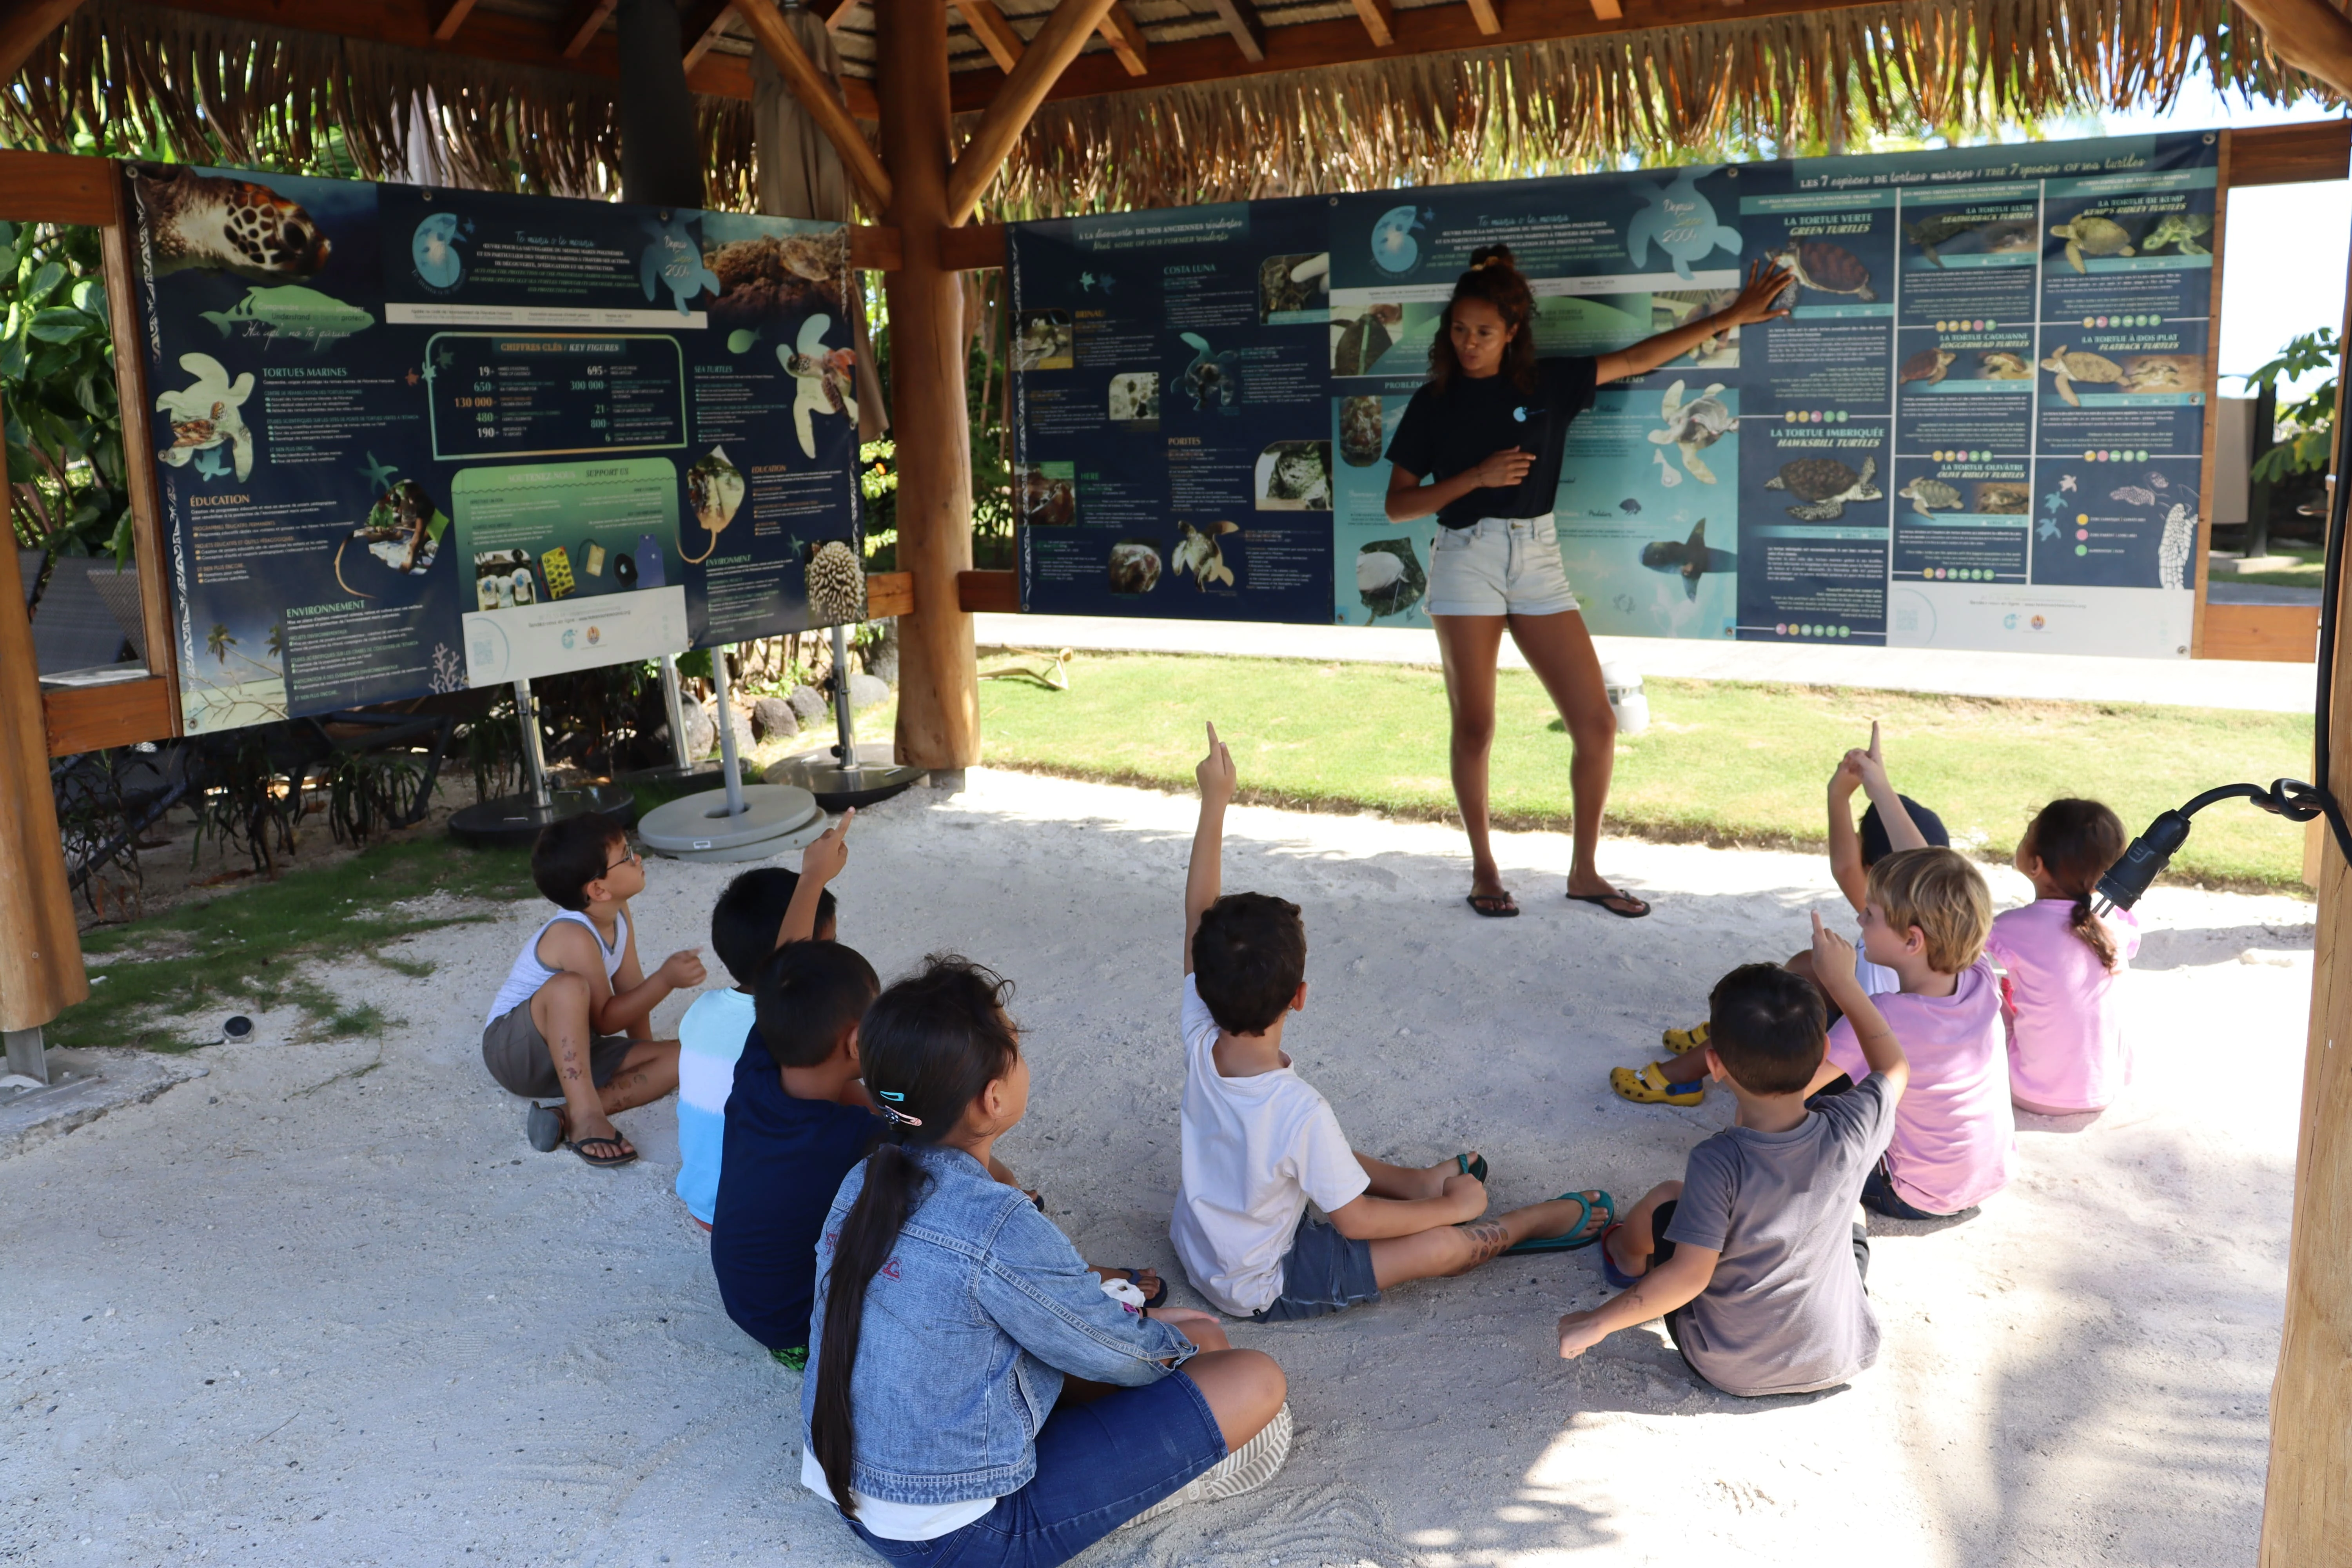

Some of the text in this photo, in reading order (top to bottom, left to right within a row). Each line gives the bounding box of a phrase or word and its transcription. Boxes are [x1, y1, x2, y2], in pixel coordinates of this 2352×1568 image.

[1800, 178, 1818, 188] LES
[1821, 175, 1828, 186] 7
[1830, 173, 1871, 190] espèces
[1873, 175, 1887, 183] DE
[1889, 170, 1927, 183] tortues
[1930, 169, 1974, 180] marines
[1985, 167, 2007, 176] THE
[2009, 163, 2019, 176] 7
[2019, 163, 2060, 179] species
[2063, 162, 2080, 172] OF
[2081, 161, 2100, 171] sea
[2104, 152, 2146, 169] turtles
[1784, 213, 1873, 225] LA TORTUE VERTE
[1163, 223, 1203, 233] ANCIENNES
[1789, 223, 1871, 236] GREEN TURTLES
[1163, 236, 1195, 244] FORMER
[1163, 263, 1216, 275] COSTA LUNA
[272, 312, 310, 321] Understand
[2128, 333, 2135, 342] À
[501, 343, 540, 351] CHIFFRES
[542, 342, 562, 351] CLÉS
[263, 368, 347, 377] TORTUES MARINES
[569, 380, 586, 390] 300
[454, 397, 472, 408] 130
[1785, 428, 1824, 437] TORTUE
[1826, 426, 1884, 438] IMBRIQUÉE
[605, 433, 611, 442] 6
[1777, 438, 1880, 447] HAWKSBILL TURTLES
[751, 465, 786, 475] EDUCATION
[190, 494, 250, 507] ÉDUCATION
[706, 554, 751, 567] ENVIRONMENT
[287, 600, 365, 617] ENVIRONNEMENT
